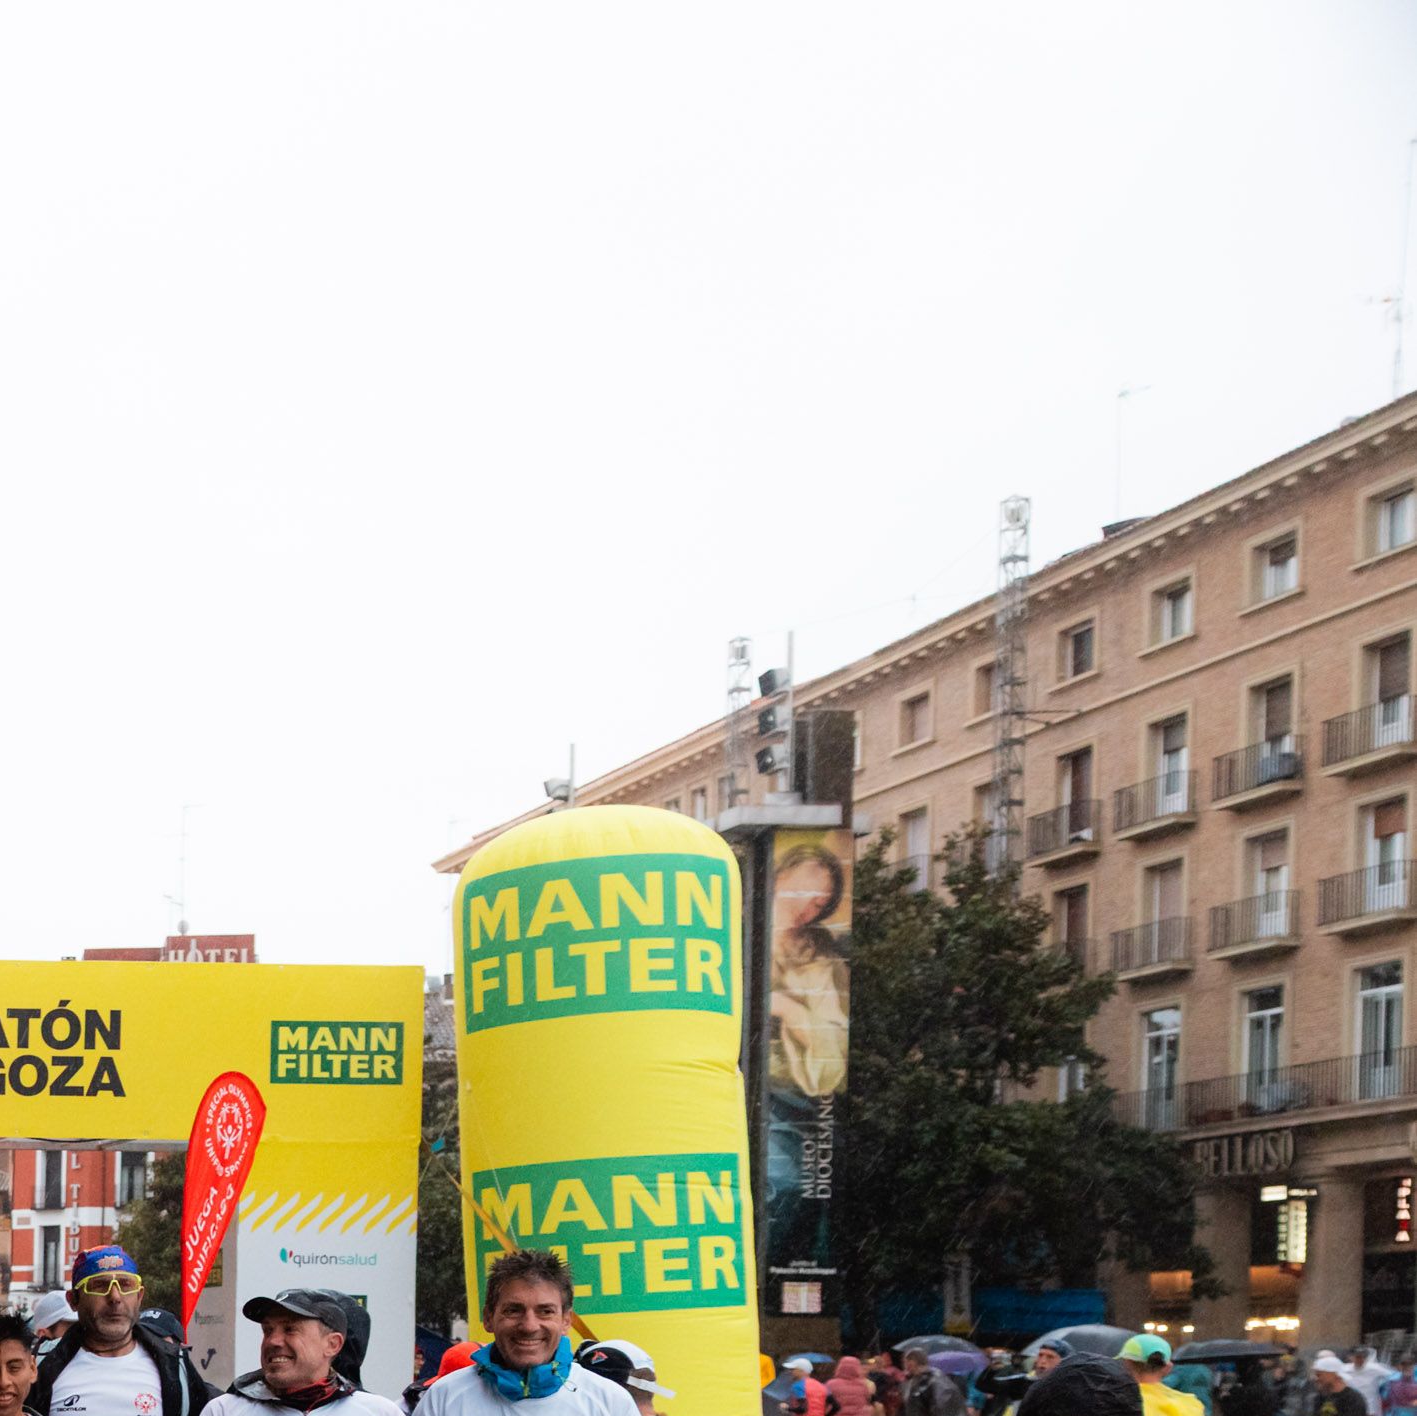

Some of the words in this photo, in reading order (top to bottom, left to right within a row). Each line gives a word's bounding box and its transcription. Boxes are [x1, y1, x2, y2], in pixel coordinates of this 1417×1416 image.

[470, 871, 723, 951] MANN
[471, 937, 727, 1015] FILTER
[276, 1026, 397, 1052] MANN
[276, 1053, 397, 1080] FILTER
[206, 1088, 229, 1126] SPECIAL
[800, 1139, 816, 1200] MUSEO
[185, 1186, 218, 1261] JUEGA
[480, 1170, 735, 1240] MANN
[293, 1253, 377, 1267] quirónsalud
[485, 1235, 740, 1298] LTER
